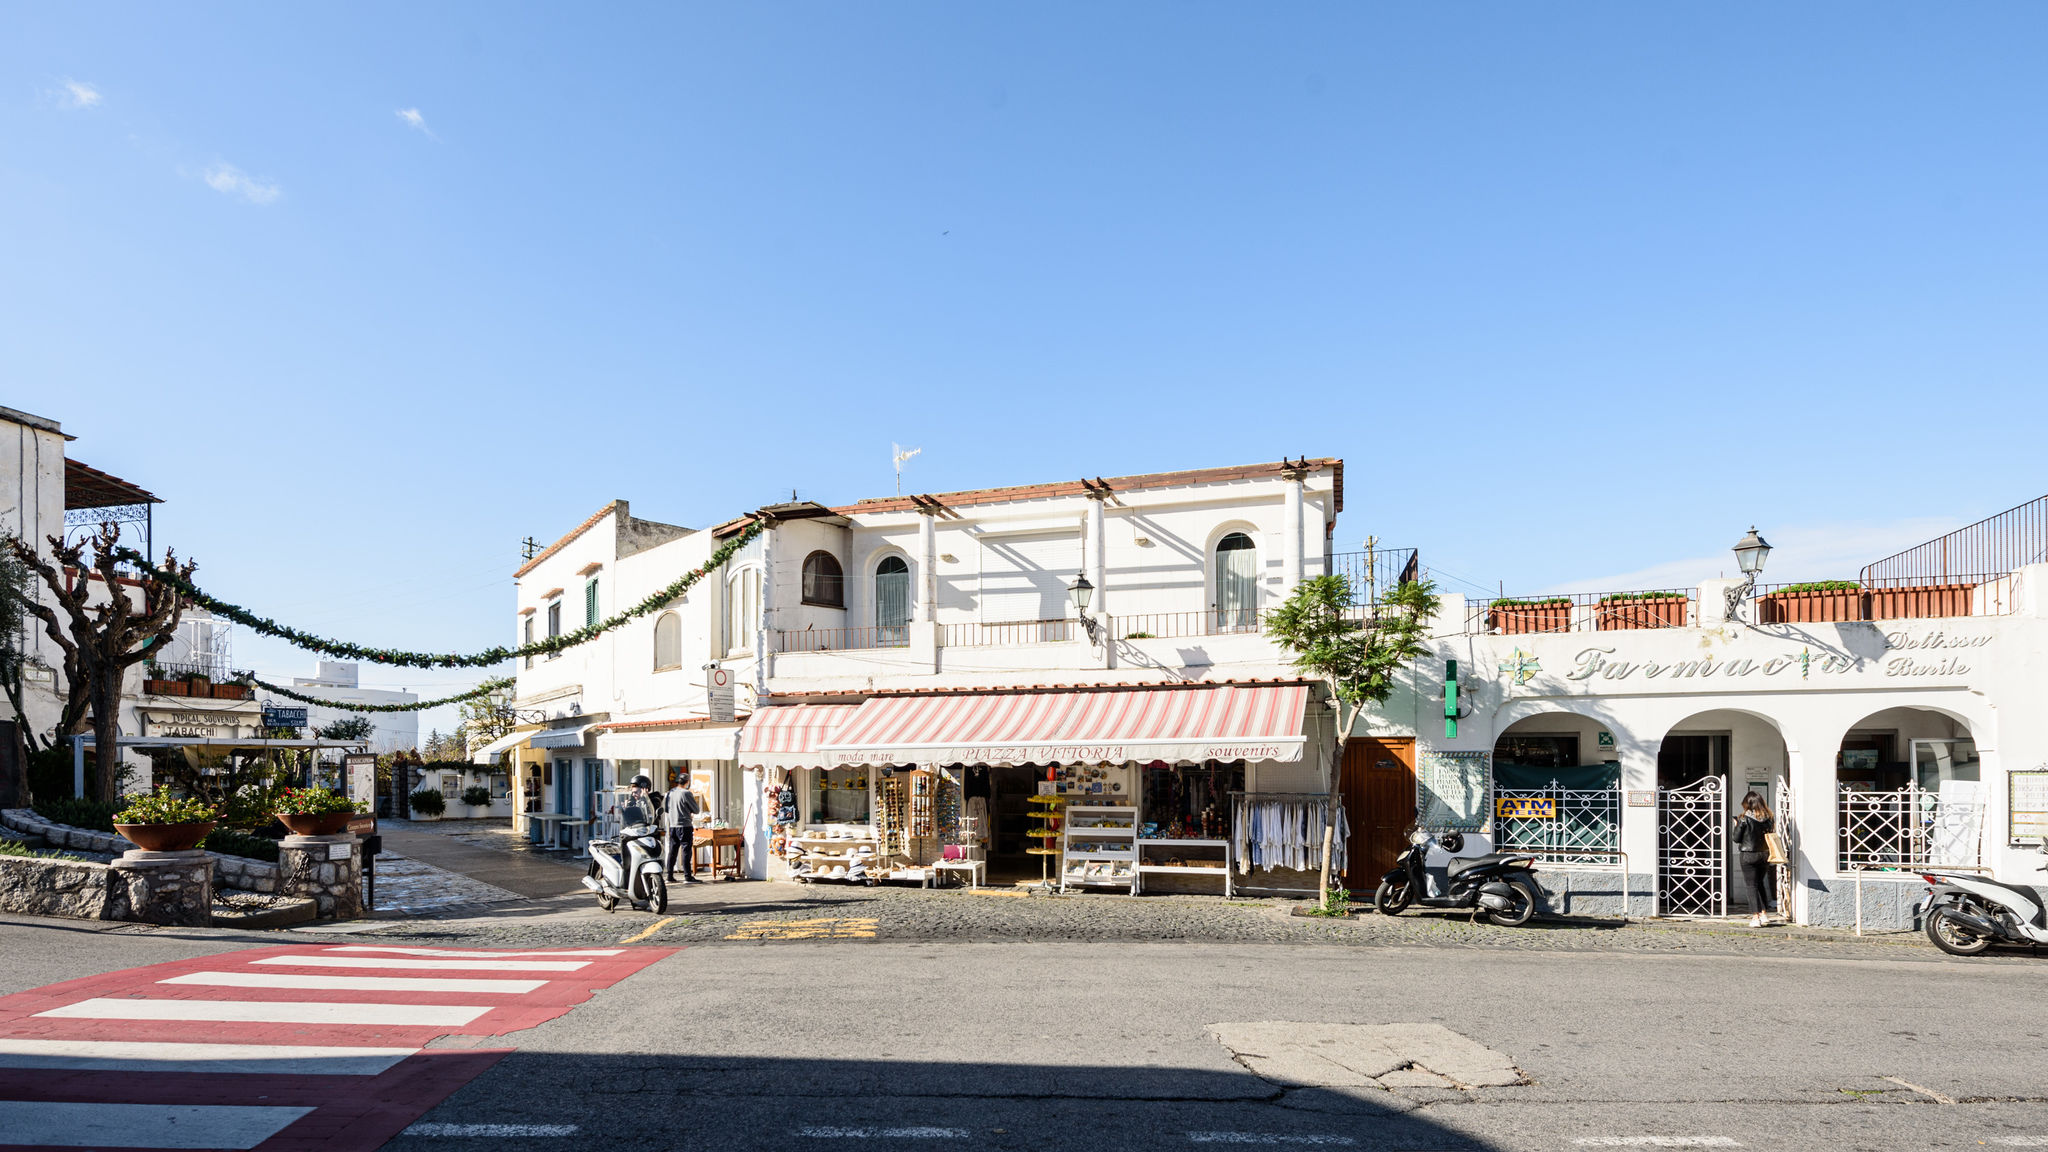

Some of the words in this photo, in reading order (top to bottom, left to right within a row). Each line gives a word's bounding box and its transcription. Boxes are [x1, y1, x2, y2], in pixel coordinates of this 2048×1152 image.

[1885, 630, 1992, 651] Dott.ssa
[1885, 656, 1972, 677] Barile
[172, 713, 201, 722] TYPICAL
[204, 715, 240, 724] SOUVENIRS
[167, 727, 215, 736] TABACCHI
[838, 750, 864, 762] moda
[870, 751, 894, 762] mare
[963, 748, 1028, 761] PIAZZA
[1039, 746, 1124, 760] VITTORIA
[1207, 745, 1280, 758] souvenirs
[1501, 800, 1552, 809] ATM
